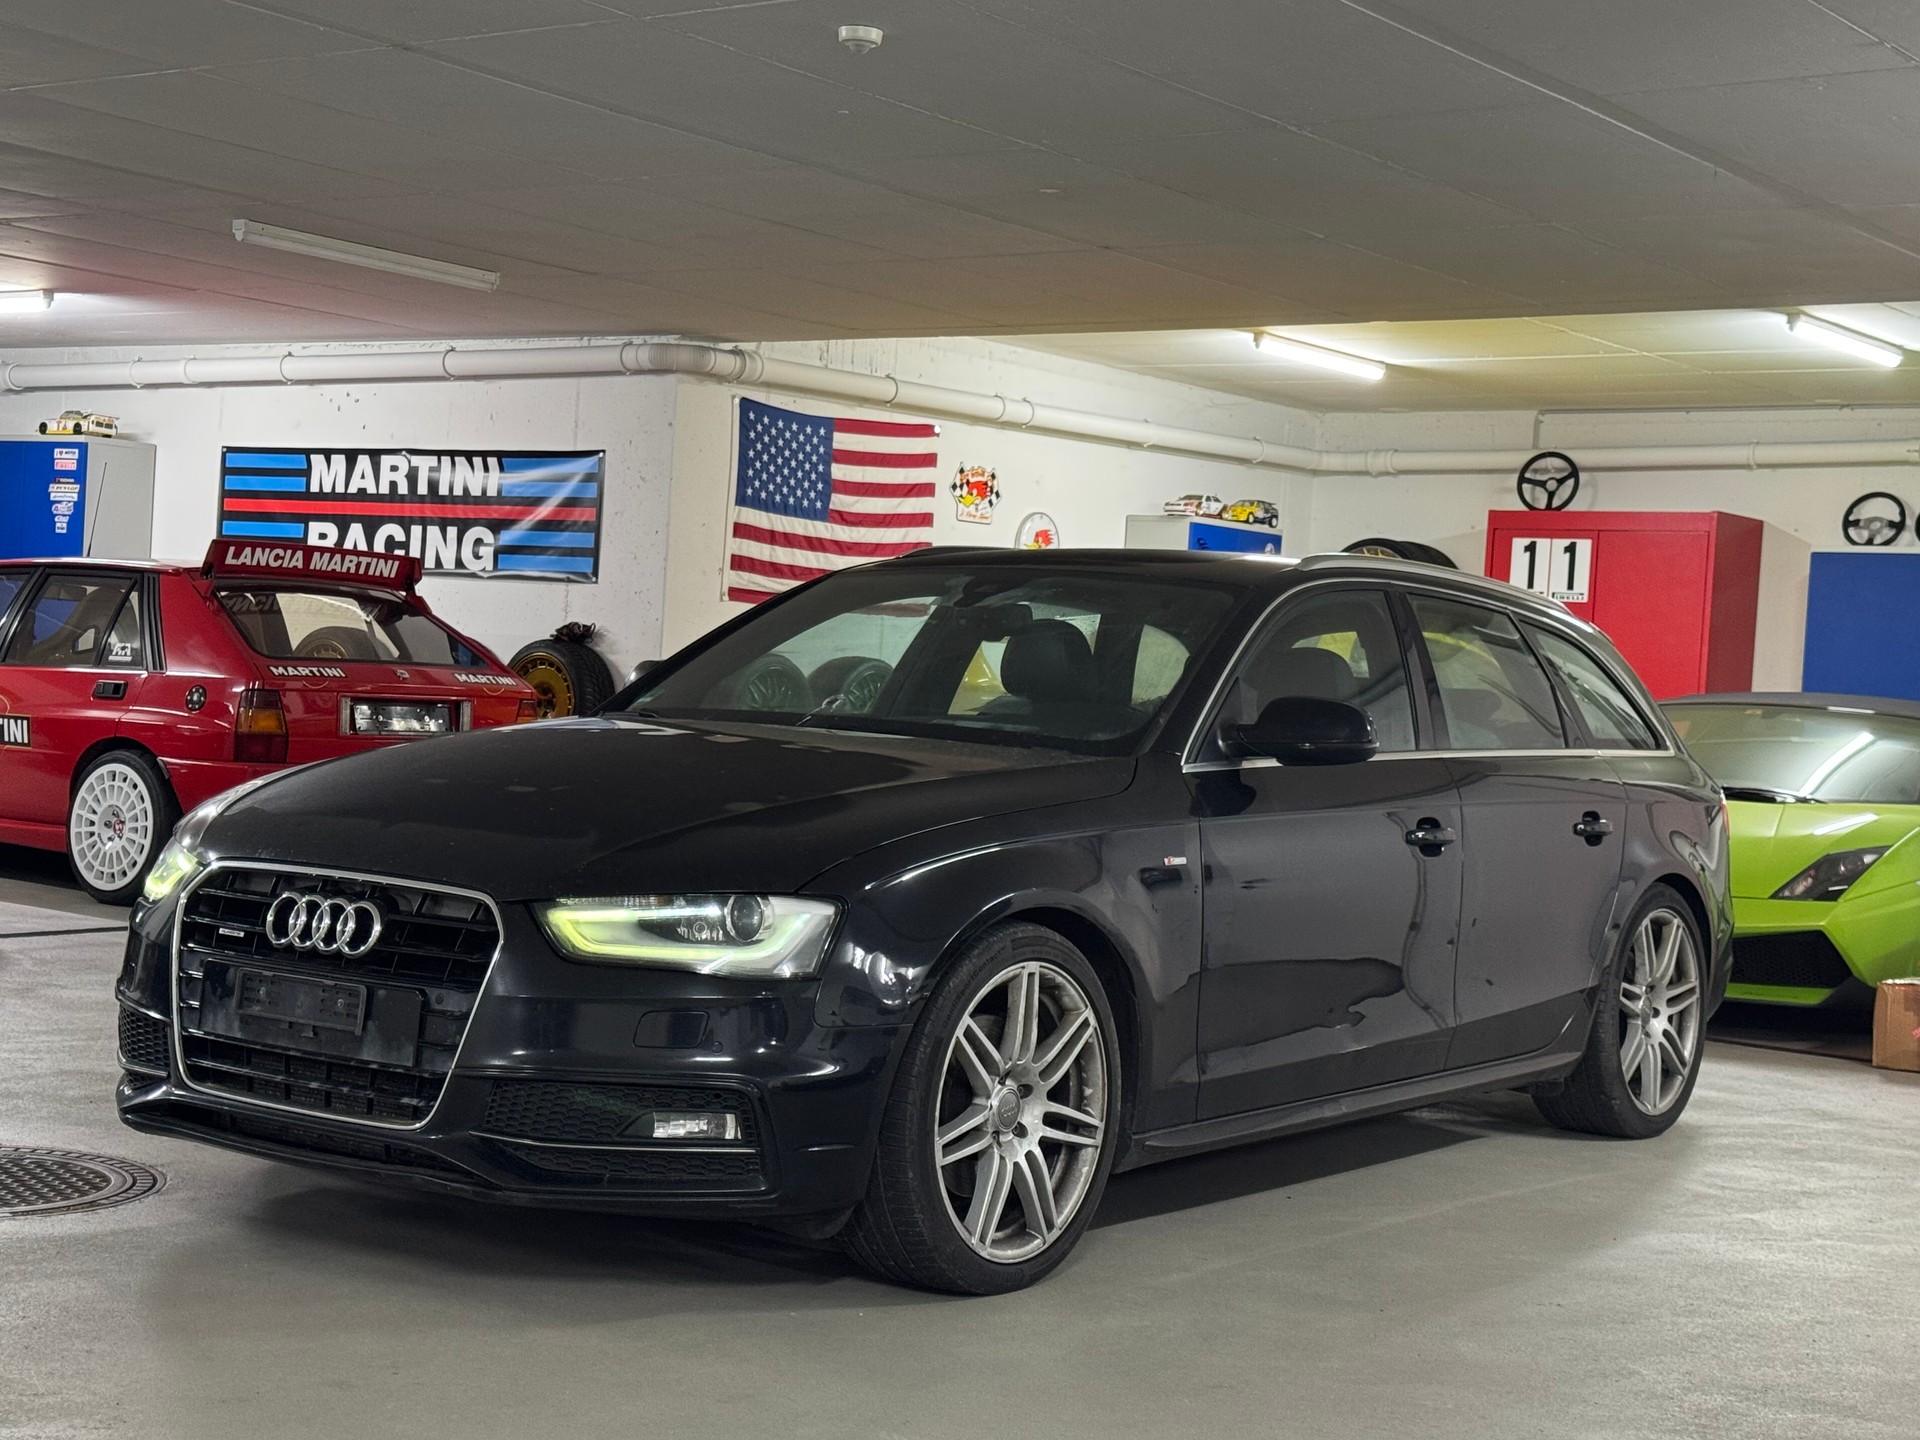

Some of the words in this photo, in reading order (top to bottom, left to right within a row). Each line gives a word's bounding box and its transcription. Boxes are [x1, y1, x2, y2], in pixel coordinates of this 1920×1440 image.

[309, 454, 501, 497] MARTINI
[306, 522, 495, 571] RACING
[225, 546, 303, 569] LANCIA
[309, 553, 400, 579] MARTINI
[269, 665, 346, 678] MARTINI
[454, 673, 516, 686] MARTINI
[0, 717, 29, 744] INI
